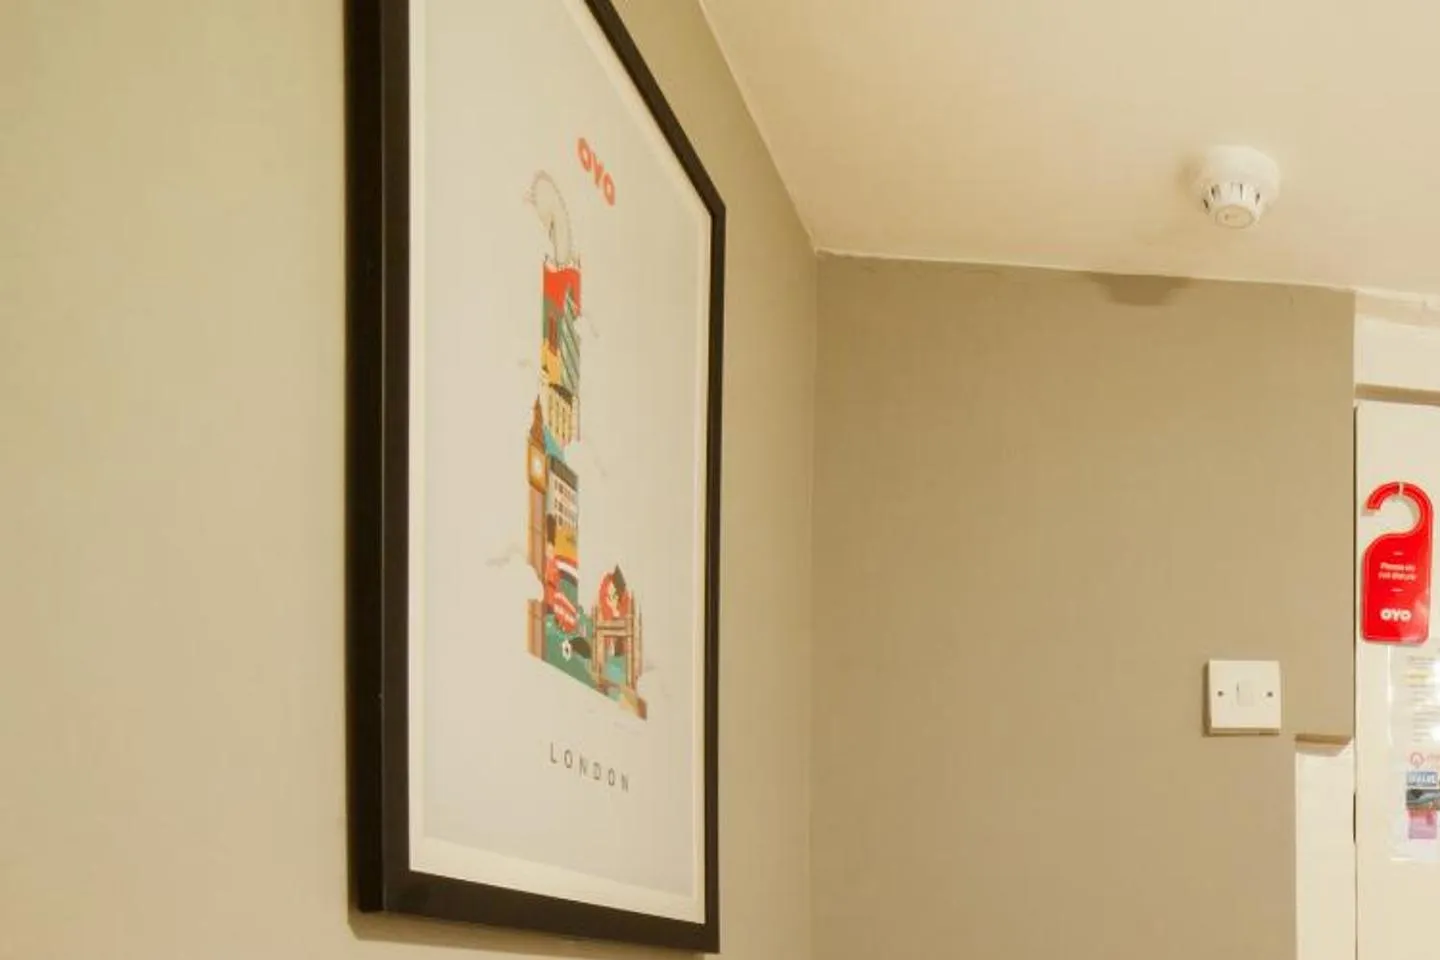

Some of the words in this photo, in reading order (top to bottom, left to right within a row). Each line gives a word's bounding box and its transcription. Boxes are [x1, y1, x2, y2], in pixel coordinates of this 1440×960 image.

[577, 137, 616, 207] OYO
[1380, 608, 1412, 622] OYO
[549, 741, 629, 793] LONDON
